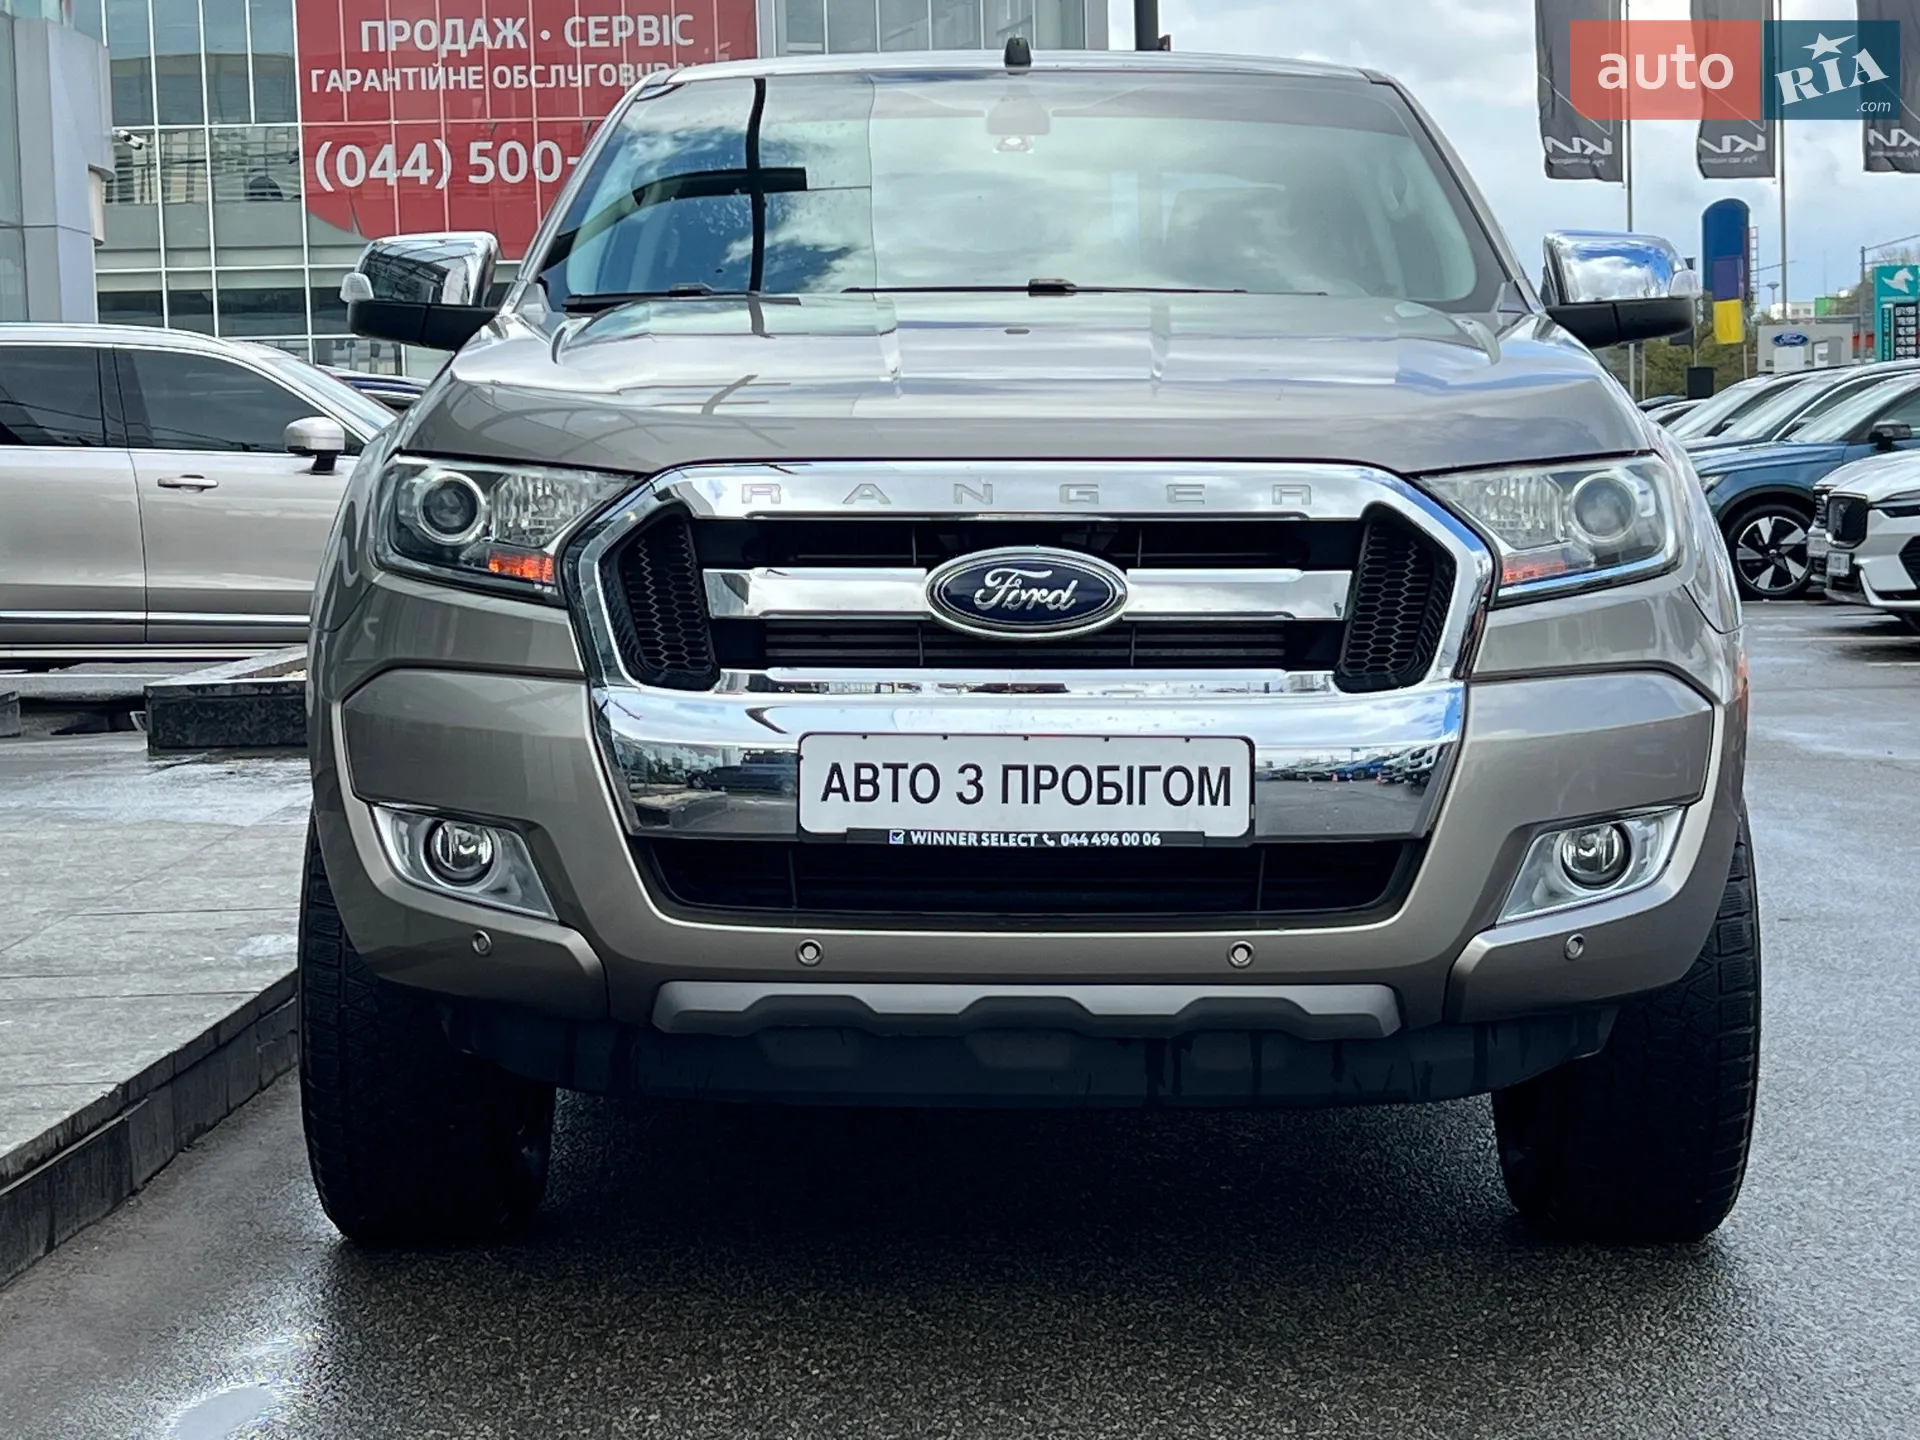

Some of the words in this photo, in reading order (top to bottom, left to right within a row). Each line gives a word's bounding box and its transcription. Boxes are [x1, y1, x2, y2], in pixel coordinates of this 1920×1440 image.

[360, 18, 528, 58] ПРОДАЖ
[564, 14, 695, 49] СЕРВІС
[310, 62, 485, 93] ГАРАНТІЙНЕ
[314, 138, 452, 192] (044)
[740, 483, 1313, 505] RANGER
[973, 566, 1079, 612] Ford
[820, 762, 941, 804] АВТО
[1000, 764, 1232, 807] ПРОБІГОМ
[910, 830, 978, 847] WINNER
[981, 832, 1038, 847] SELECT
[1060, 832, 1088, 847] 044
[1091, 832, 1118, 847] 496
[1121, 832, 1140, 847] 00
[1142, 832, 1161, 847] 06
